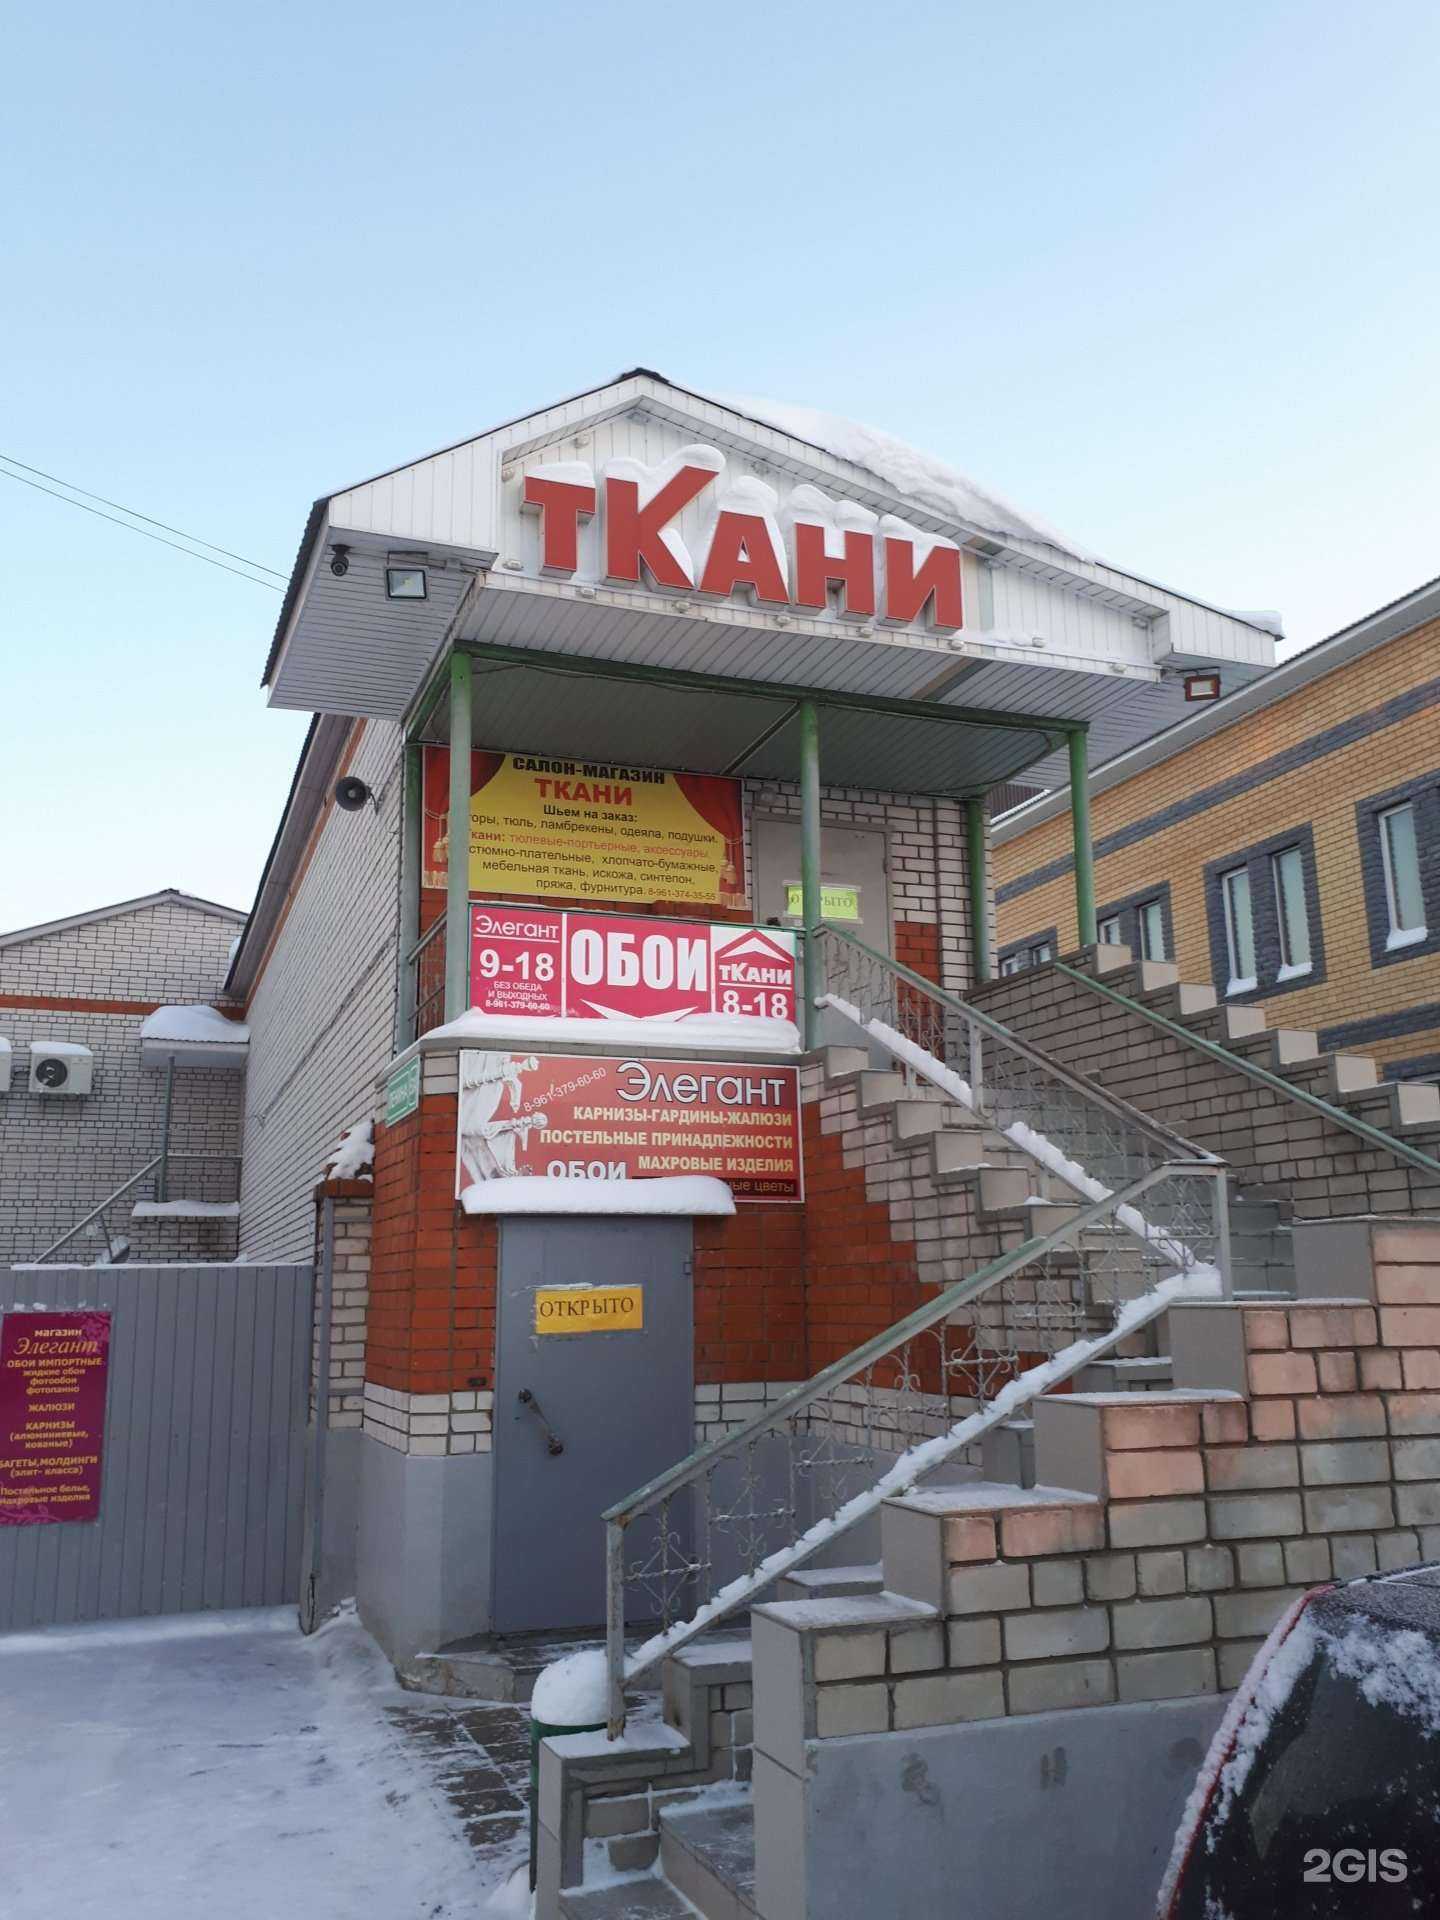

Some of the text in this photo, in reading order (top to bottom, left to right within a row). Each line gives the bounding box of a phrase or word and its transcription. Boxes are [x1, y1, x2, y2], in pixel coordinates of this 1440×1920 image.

[512, 758, 665, 785] САЛОН-МАГАЗИН
[534, 778, 632, 806] ТКАНИ
[543, 804, 638, 823] Шьем на заказ:
[503, 817, 537, 829] тюль,
[540, 820, 617, 837] ламбрекены,
[482, 860, 549, 875] мебельная
[536, 879, 577, 892] пряжа,
[475, 915, 559, 939] Элегант
[480, 948, 555, 982] 9-18
[570, 929, 708, 992] ОБОИ
[493, 981, 543, 992] БЕЗ ОБЕДА
[497, 990, 548, 1001] ВЫХОДНЫХ
[722, 990, 789, 1019] 8-18
[616, 1060, 786, 1106] Элегант
[573, 1105, 793, 1126] КАРНИЗЫ-ГАРДИНЫ-ЖАЛЮЗИ
[540, 1129, 793, 1149] ПОСТЕЛЬНЫЕ ПРИНАДЛЕЖНОСТИ
[547, 1160, 627, 1179] ОБОИ
[638, 1155, 794, 1174] МАХРОВЫЕ ИЗДЕЛИЯ
[754, 1181, 794, 1193] цветы
[540, 1297, 634, 1317] ОТКРЫТО
[34, 1328, 82, 1338] магазин
[13, 1337, 98, 1355] Элегант
[7, 1357, 103, 1368] ОБОИ ИМПОРТНЫЕ
[28, 1403, 75, 1412] ЖАЛЮЗИ
[26, 1421, 76, 1430] КАРНИЗЫ
